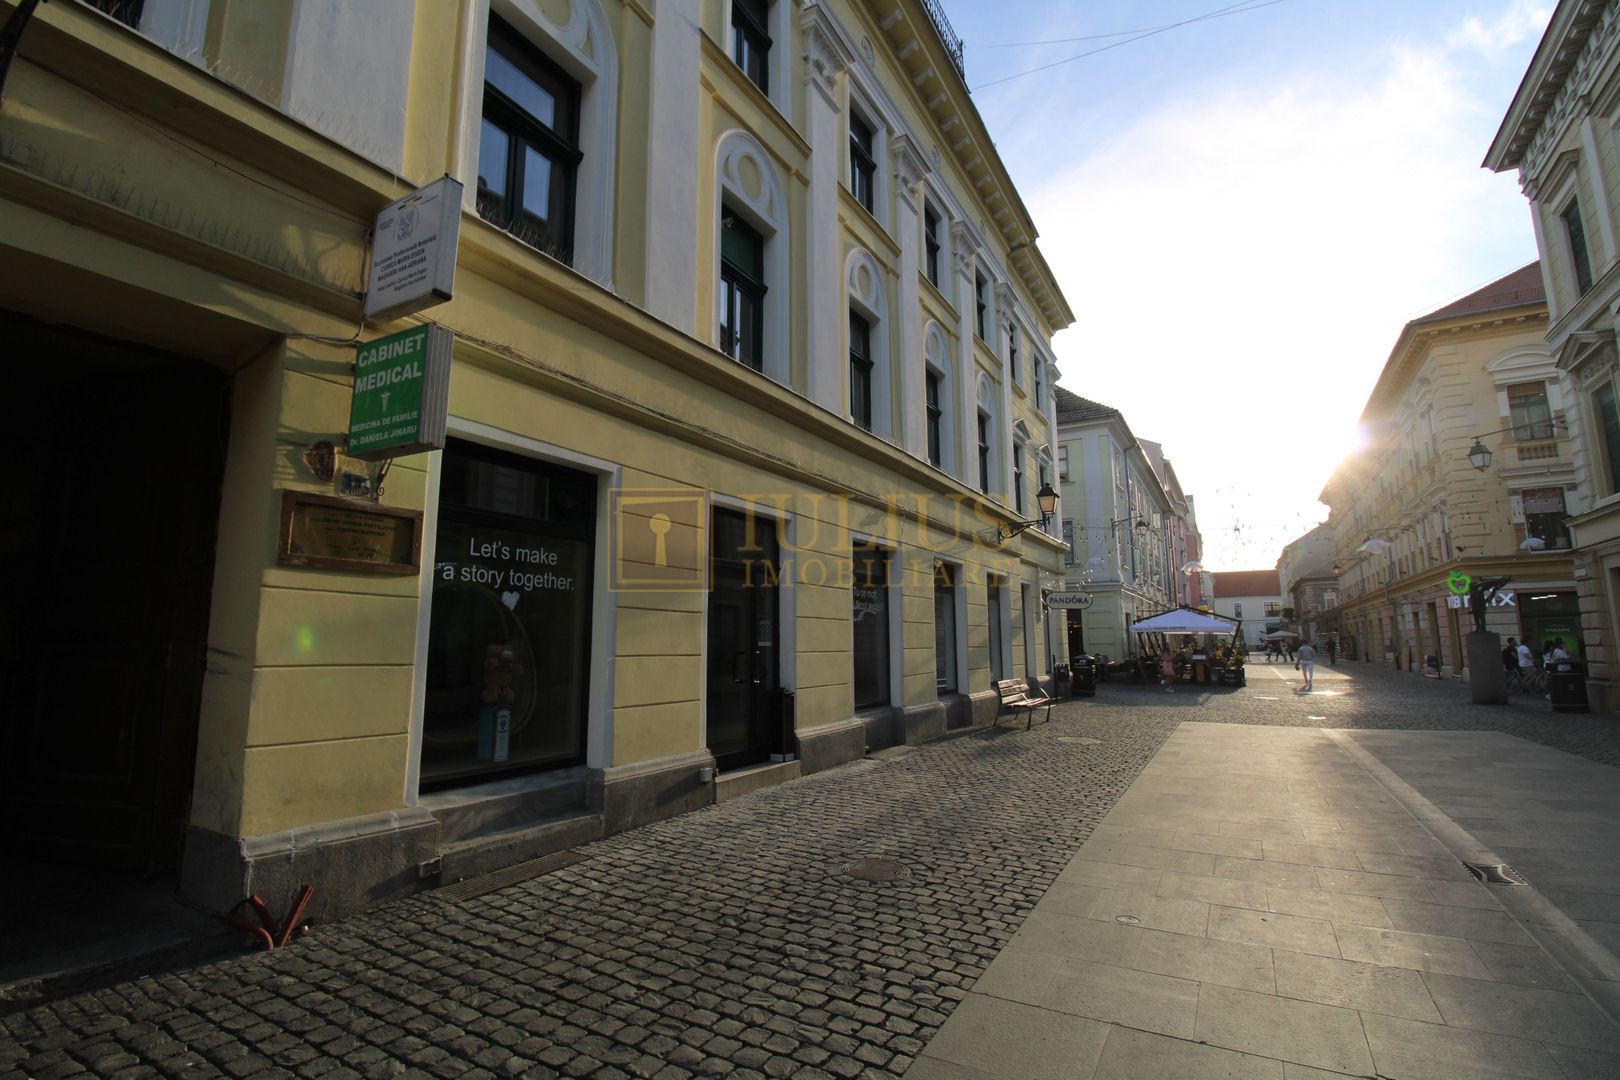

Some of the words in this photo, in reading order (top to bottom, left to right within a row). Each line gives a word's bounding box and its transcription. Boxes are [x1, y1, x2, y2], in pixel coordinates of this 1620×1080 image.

[358, 333, 425, 367] CABINET
[355, 361, 422, 394] MEDICAL
[351, 420, 381, 433] MEDICINA
[382, 417, 391, 426] DE
[392, 410, 419, 423] FAMILIE
[360, 430, 389, 444] DANIELA
[469, 537, 511, 560] Let's
[516, 547, 558, 565] make
[442, 565, 456, 580] a
[460, 565, 505, 588] story
[509, 569, 575, 591] together.
